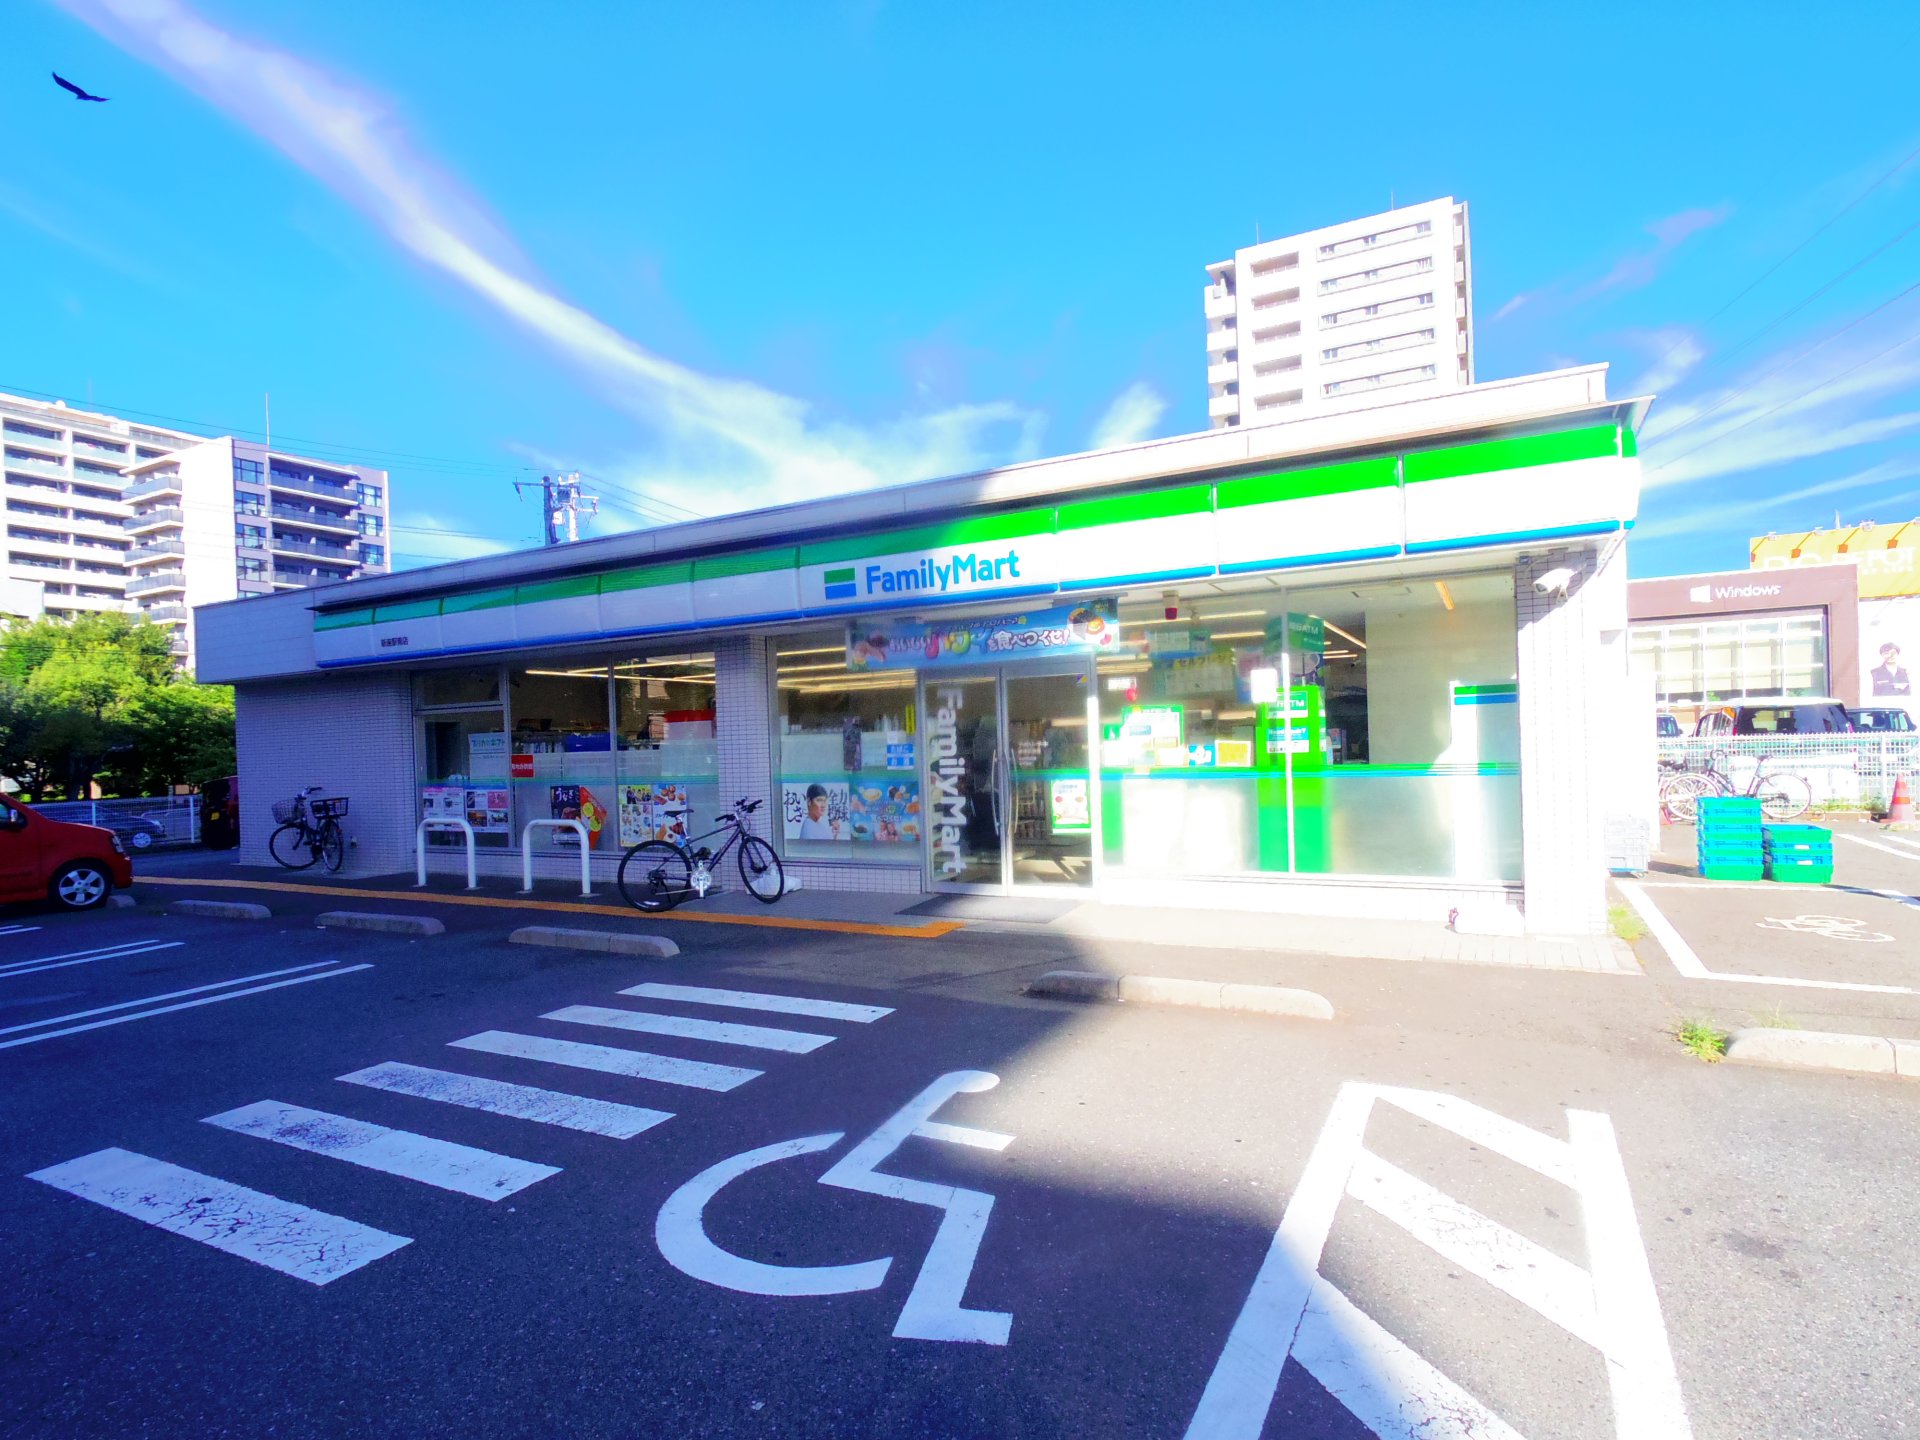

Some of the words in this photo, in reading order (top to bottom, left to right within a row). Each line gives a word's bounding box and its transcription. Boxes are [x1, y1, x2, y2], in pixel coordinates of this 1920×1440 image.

[866, 550, 1020, 594] FamilyMart
[1715, 583, 1781, 599] Windows
[936, 689, 967, 874] FamilyMart
